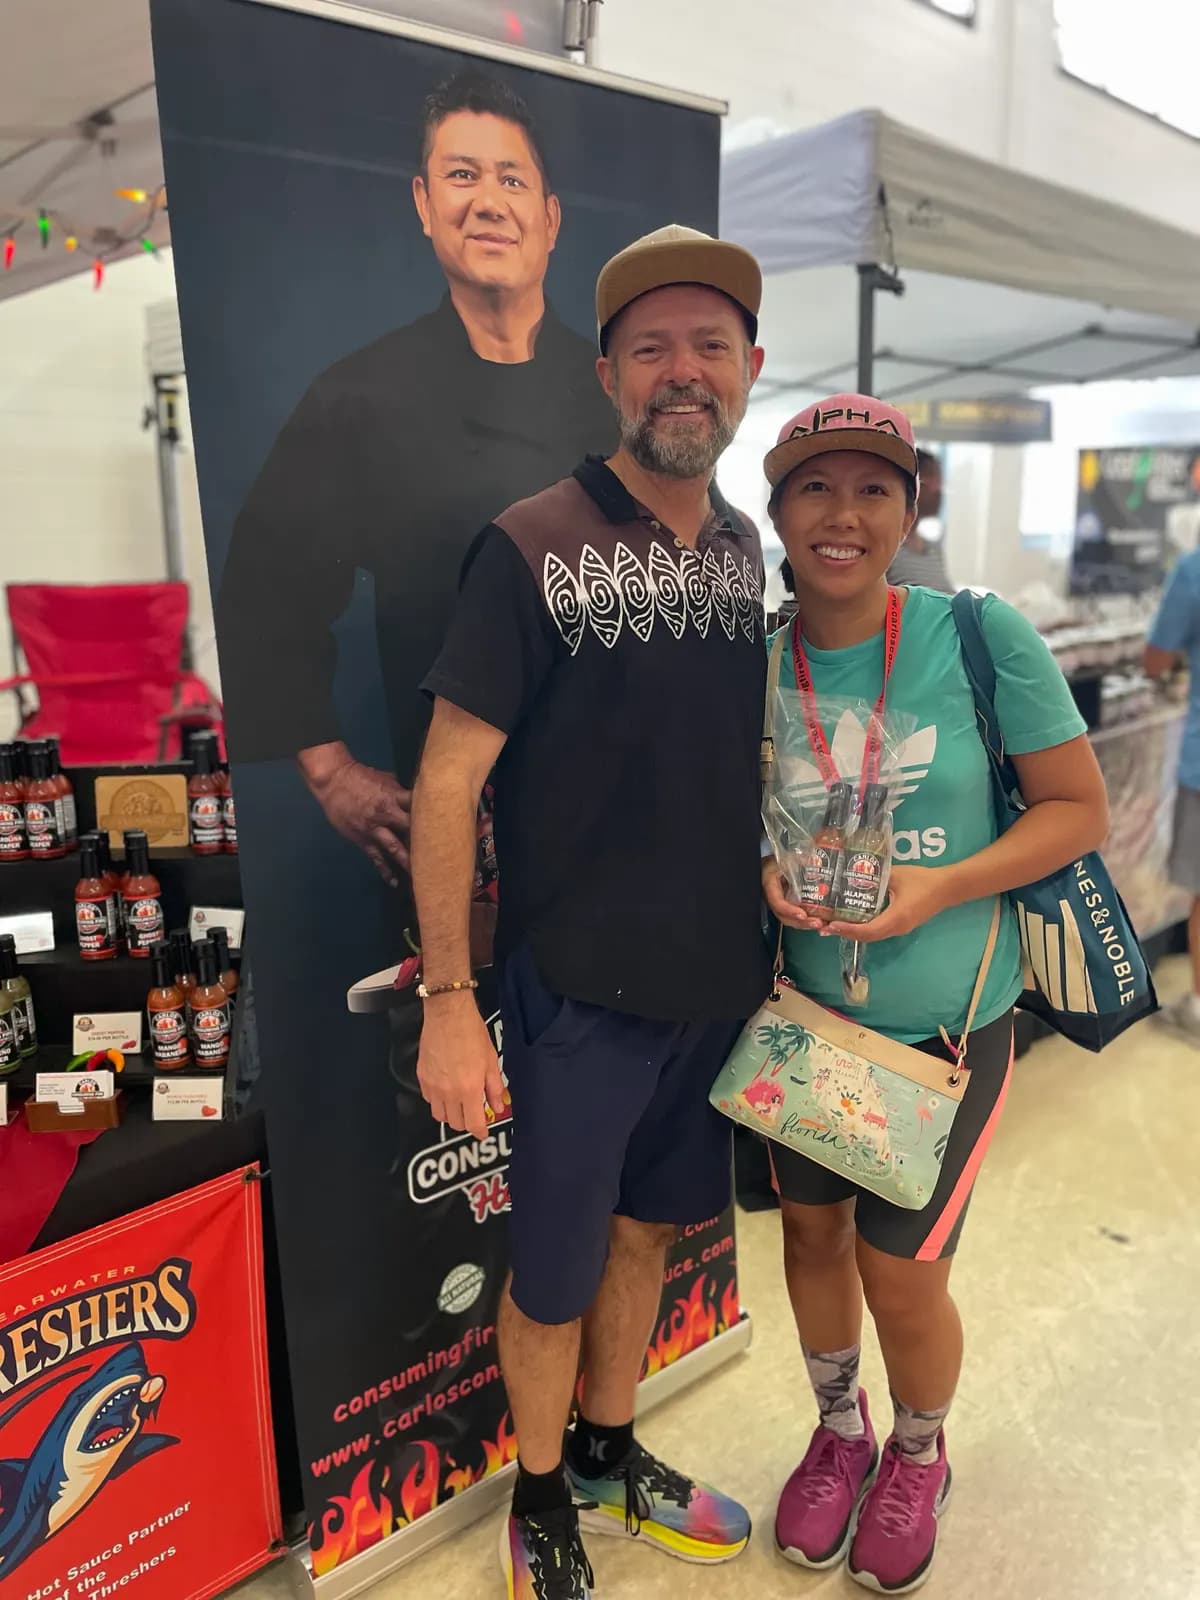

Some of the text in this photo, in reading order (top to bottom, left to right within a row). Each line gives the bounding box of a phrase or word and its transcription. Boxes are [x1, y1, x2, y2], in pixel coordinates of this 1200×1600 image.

[844, 897, 870, 908] PEPPER
[333, 1325, 495, 1423] consumingfir
[310, 1364, 499, 1478] www.carloscon
[27, 1501, 191, 1600] Hot Sauce Partner
[76, 1570, 107, 1593] the
[88, 1545, 177, 1600] Threshers
